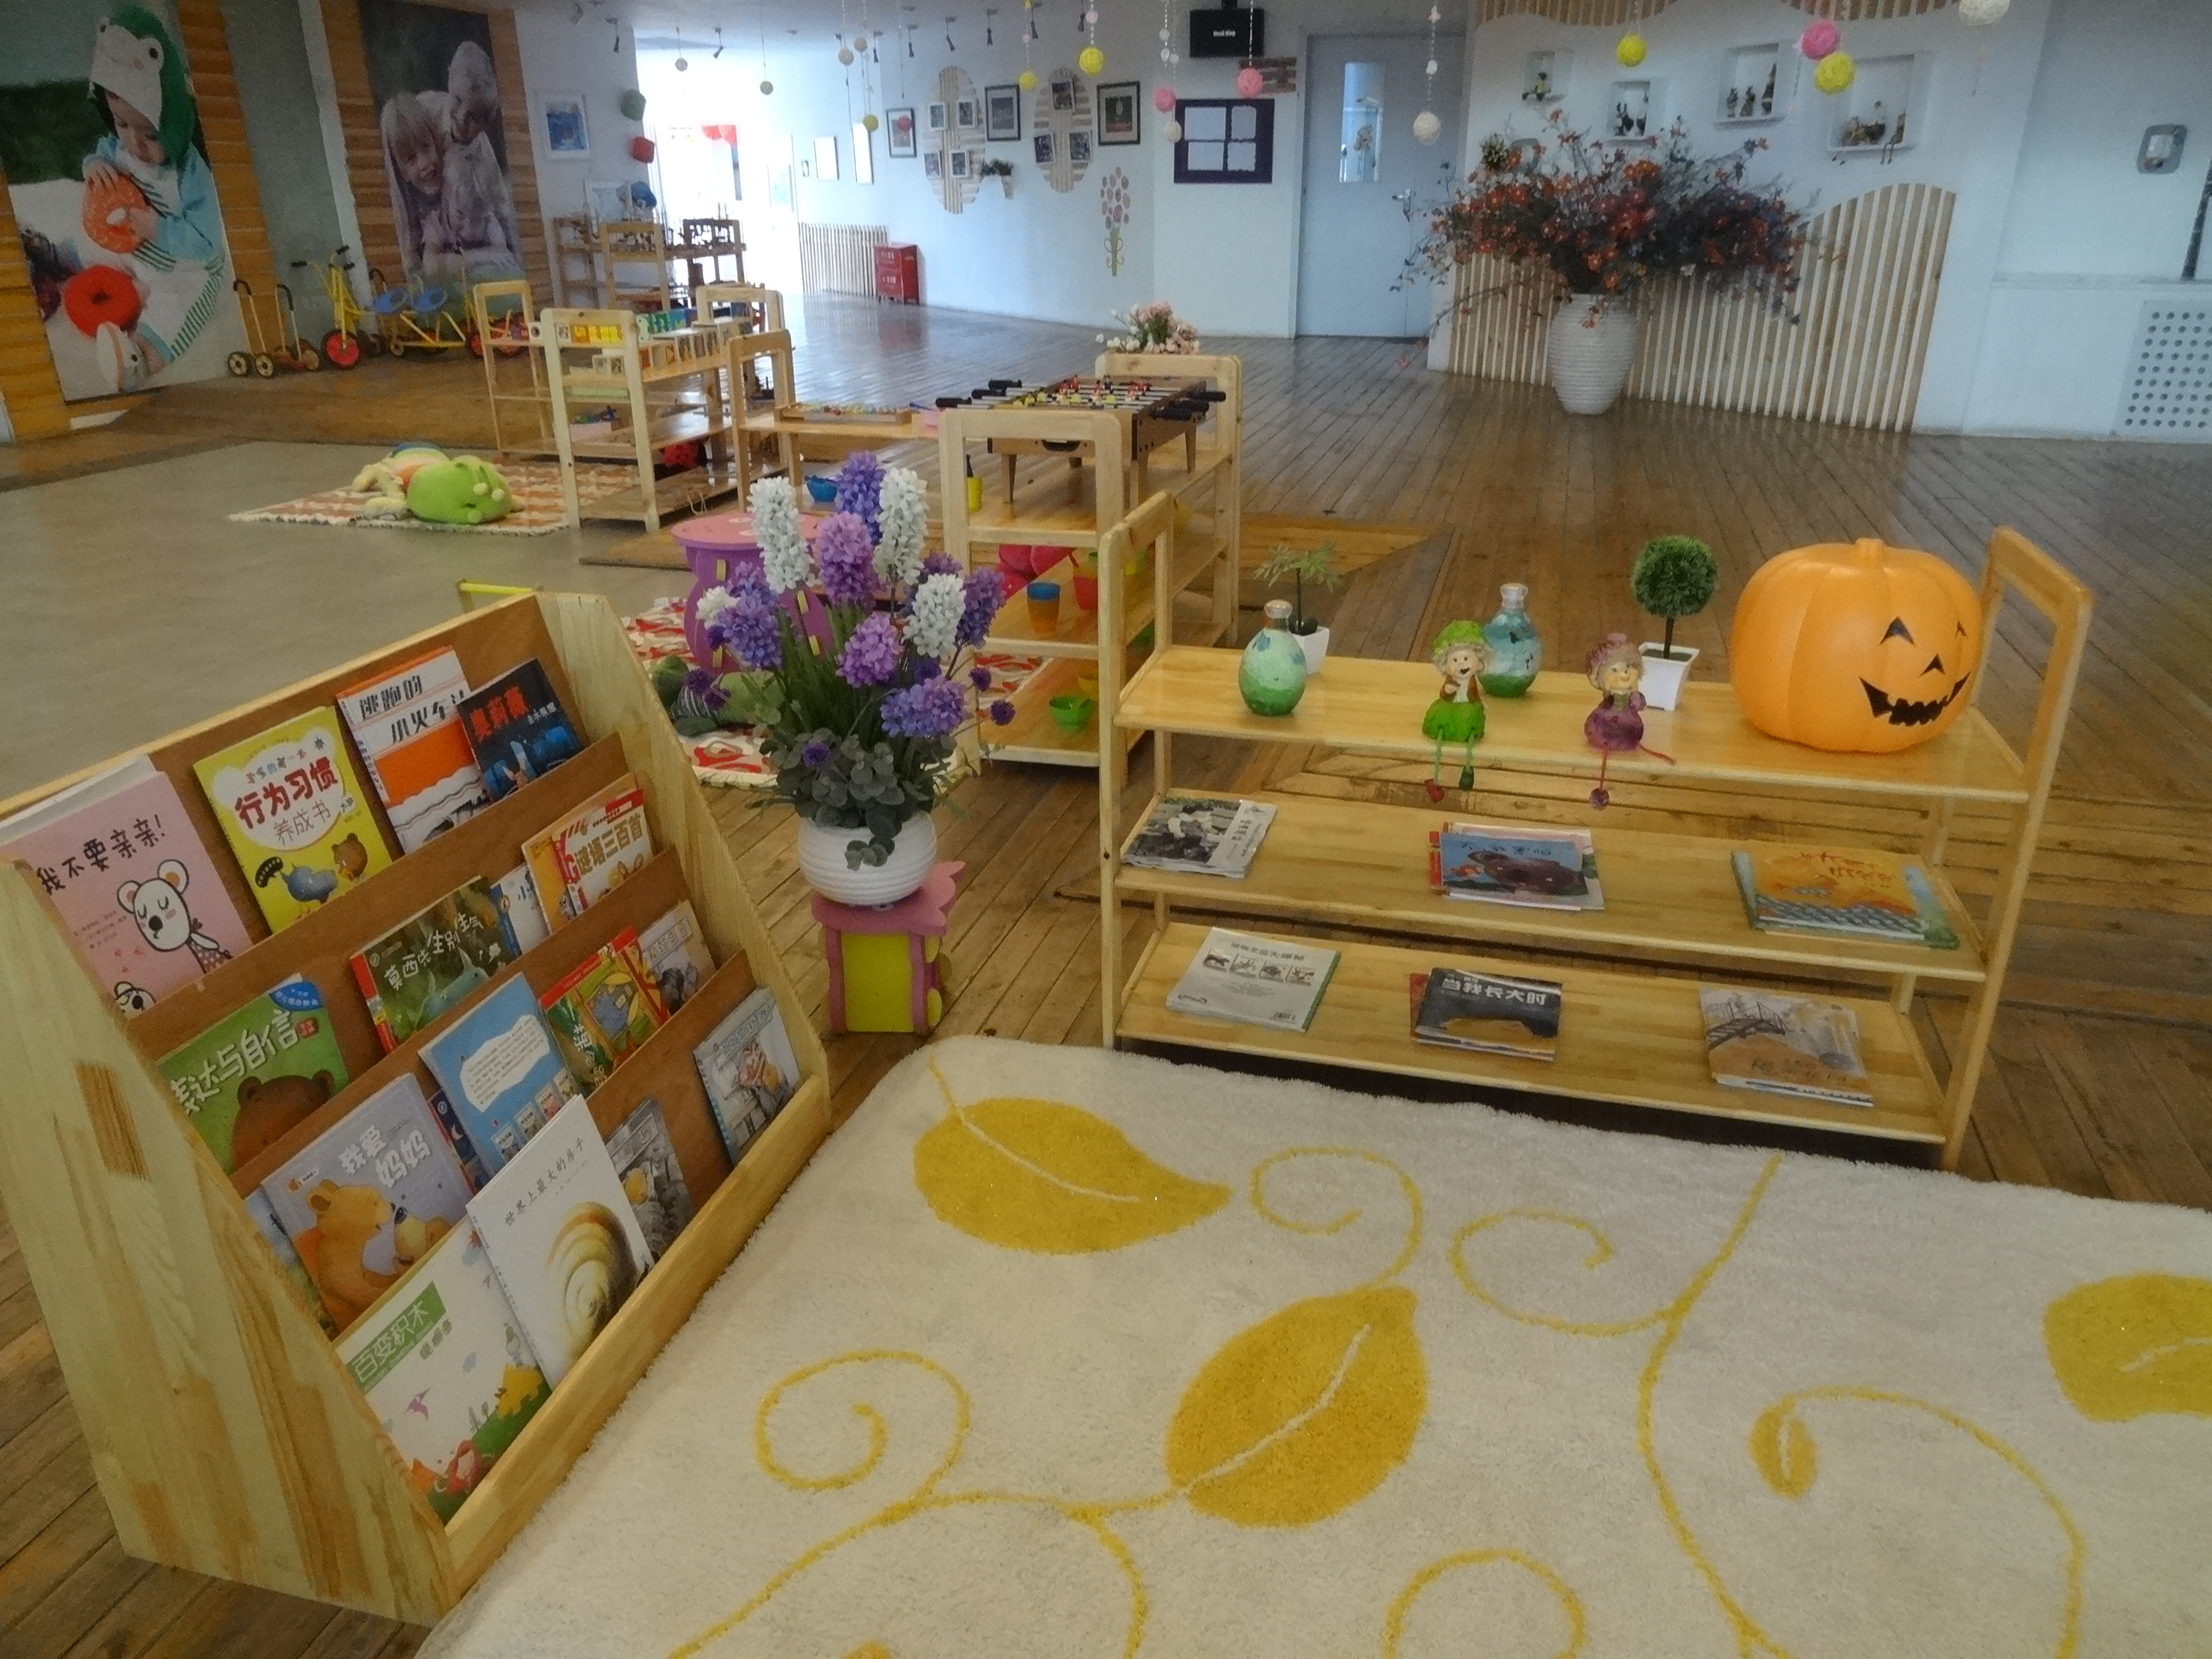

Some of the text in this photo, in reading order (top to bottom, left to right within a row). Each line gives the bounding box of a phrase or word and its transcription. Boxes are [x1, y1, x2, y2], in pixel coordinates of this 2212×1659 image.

[235, 756, 339, 829] 行为习惯
[273, 799, 331, 845] 养成书
[37, 814, 166, 895] 我不要亲亲!
[384, 911, 484, 991] 莫西先生别生气
[1441, 977, 1546, 1005] 当我长大时
[172, 1009, 298, 1114] 表达与自信
[339, 1125, 387, 1174] 我爱
[375, 1129, 430, 1188] 妈妈
[504, 1137, 584, 1226] 世界上最大的房子
[352, 1300, 428, 1382] 百变积木
